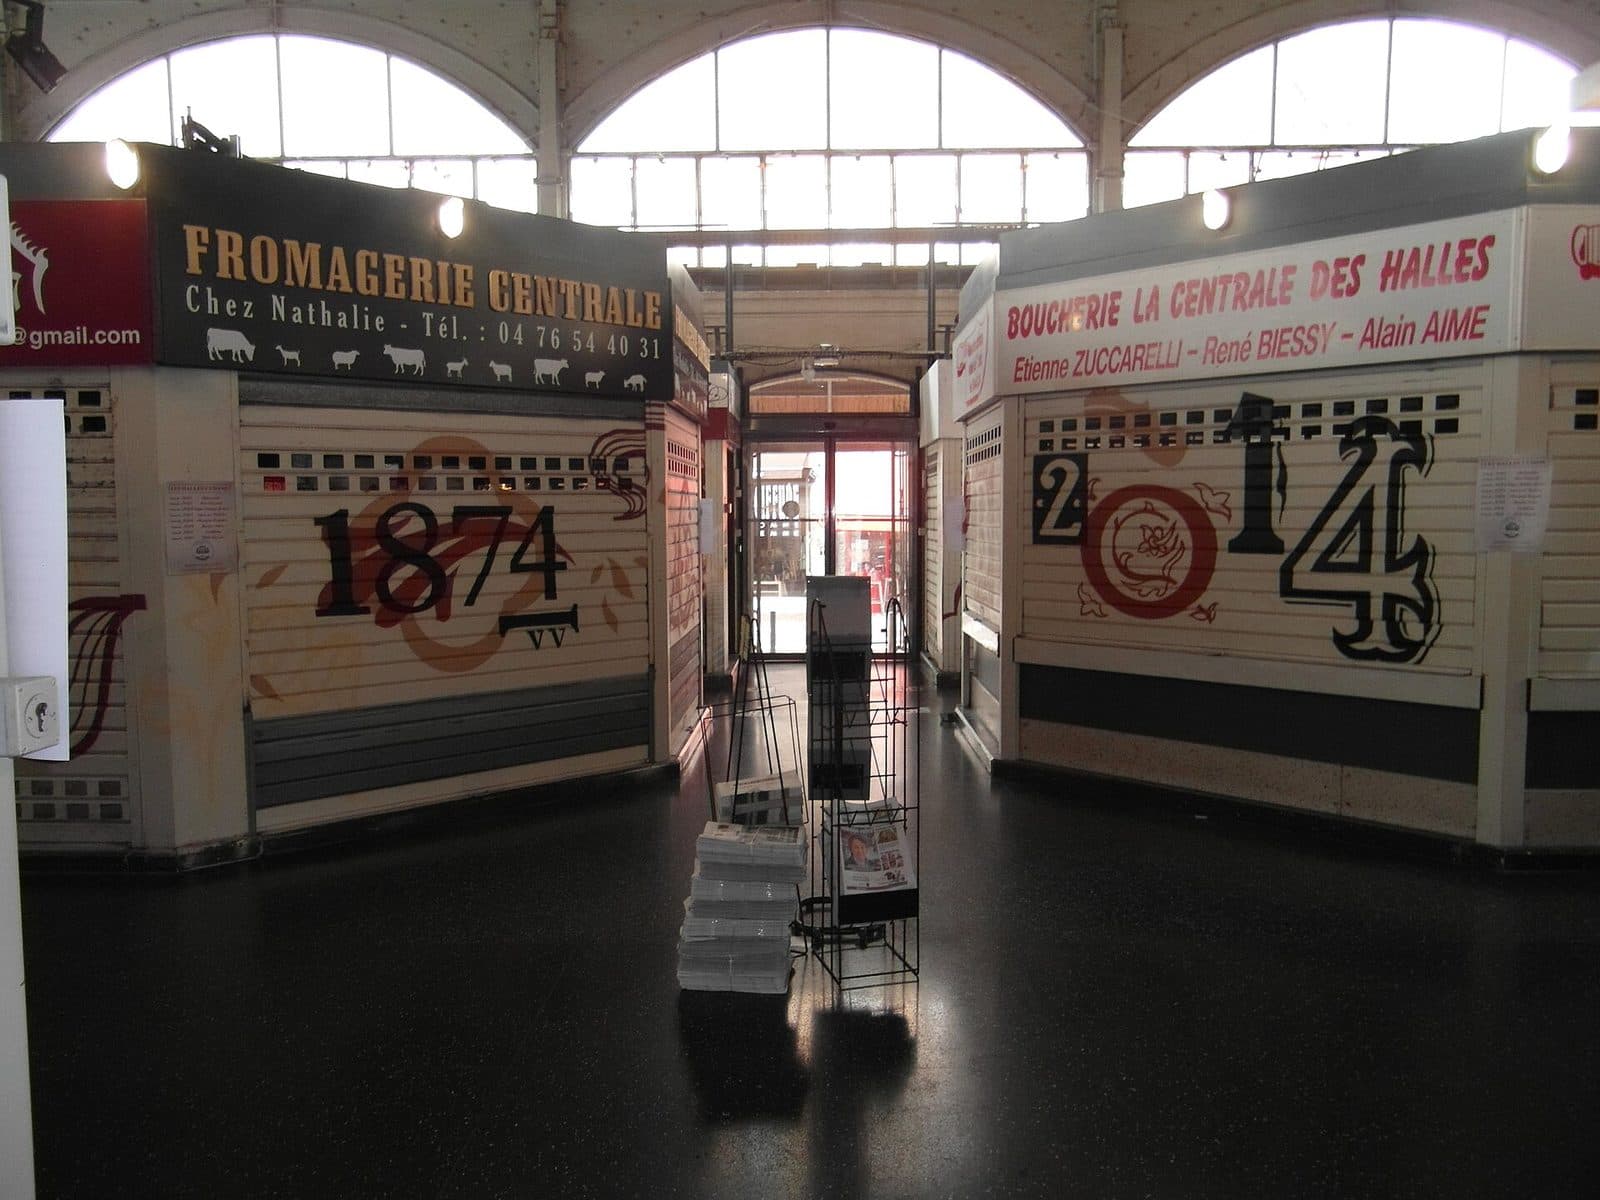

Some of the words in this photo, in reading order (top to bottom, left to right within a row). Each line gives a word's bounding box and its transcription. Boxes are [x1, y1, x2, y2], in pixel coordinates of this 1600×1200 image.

[183, 224, 474, 308] FROMAGERIE
[488, 270, 662, 330] CENTRALE
[186, 284, 254, 318] Chez
[271, 294, 385, 332] Nathalie
[422, 312, 468, 341] Tél.
[499, 321, 523, 346] 04
[537, 326, 560, 350] 76
[573, 331, 596, 353] 54
[607, 335, 629, 357] 40
[640, 337, 660, 360] 31
[1007, 291, 1122, 340] BOUCHERIE
[1133, 285, 1160, 324] LA
[1170, 265, 1297, 320] CENTRALE
[1310, 254, 1366, 301] DES
[1380, 234, 1496, 293] HALLES
[1013, 355, 1069, 383] Etienne
[1072, 339, 1183, 377] ZUCCARELLI
[1202, 331, 1252, 365] René
[1256, 322, 1337, 361] BIESSY
[1358, 314, 1416, 350] Alain
[1420, 304, 1491, 345] AIME
[314, 502, 567, 617] 1874
